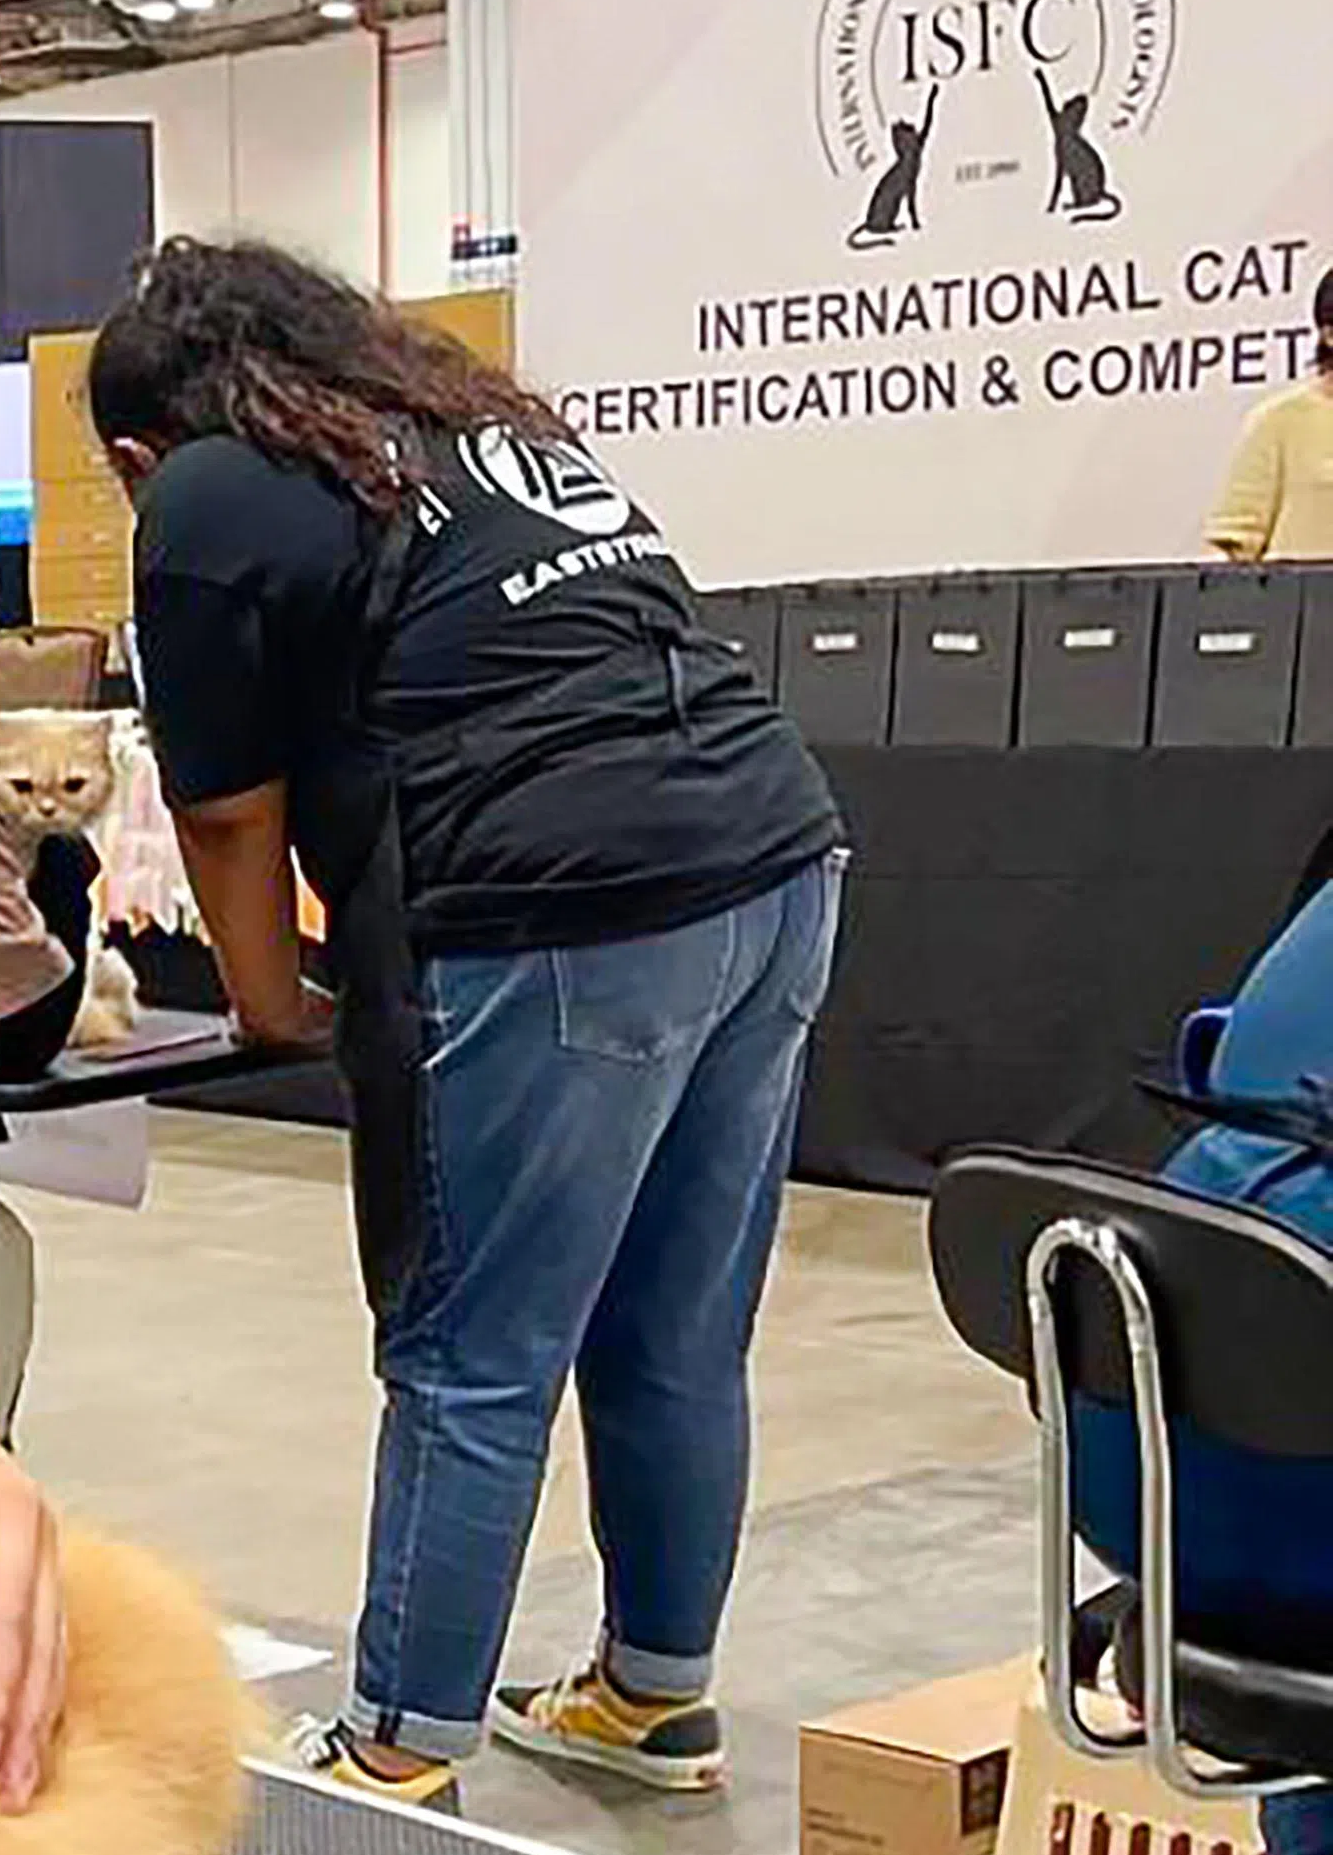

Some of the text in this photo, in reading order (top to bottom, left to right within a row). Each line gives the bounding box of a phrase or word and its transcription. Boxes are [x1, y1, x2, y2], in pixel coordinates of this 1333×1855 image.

[698, 240, 1309, 352] INTERNATIONAL CAT
[559, 360, 956, 435] CERTIFICATION
[981, 354, 1020, 407] &
